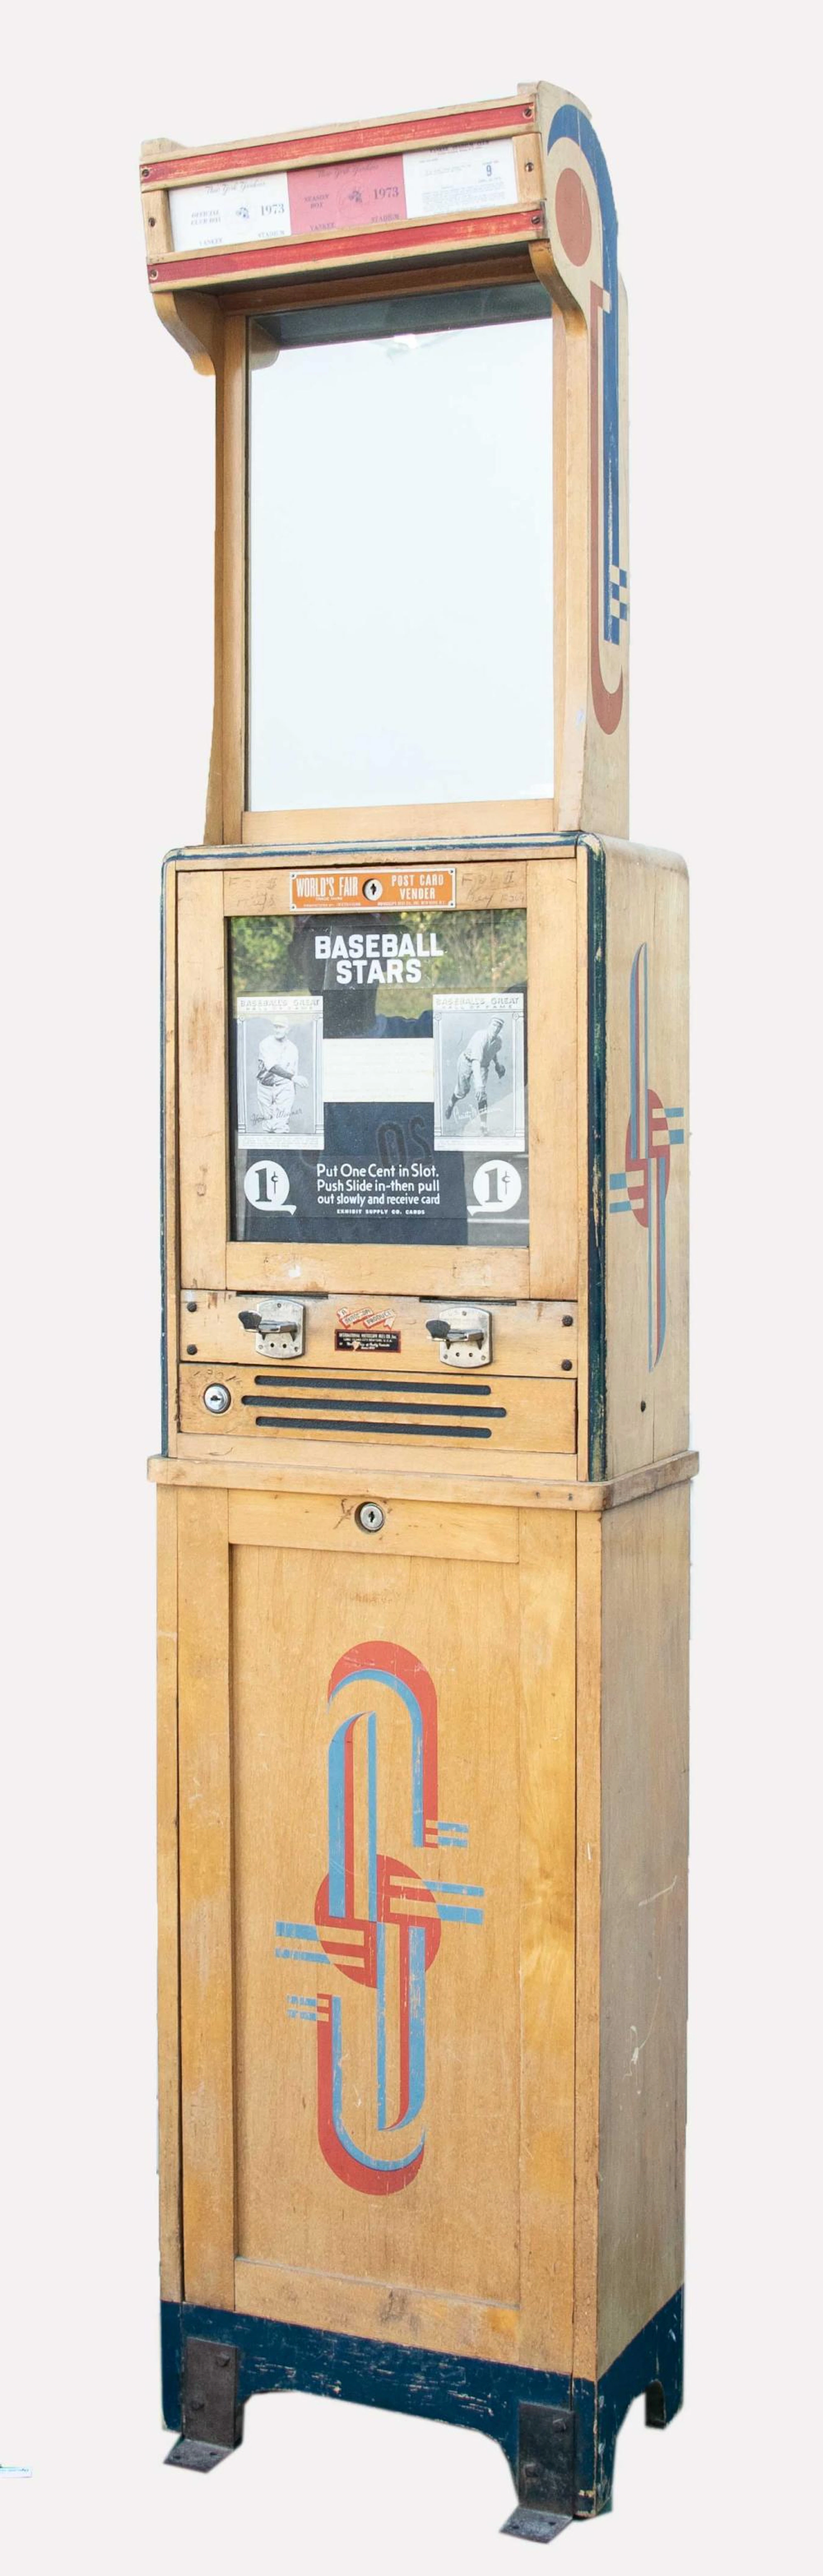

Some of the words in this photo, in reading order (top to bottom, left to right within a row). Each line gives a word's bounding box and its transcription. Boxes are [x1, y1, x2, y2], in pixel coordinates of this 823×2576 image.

[486, 165, 493, 177] 9
[373, 186, 399, 200] 1973
[261, 204, 285, 216] 1973
[296, 877, 334, 897] WORLD'S
[339, 877, 358, 896] FAIR
[391, 875, 414, 886] POST
[420, 874, 444, 886] CARD
[400, 888, 435, 900] VENDER
[315, 933, 444, 959] BASEBALL
[336, 958, 422, 984] STARS
[317, 1163, 338, 1177] Put
[340, 1163, 367, 1177] One
[368, 1163, 396, 1177] Cent
[399, 1164, 408, 1177] in
[411, 1163, 439, 1177] Slot.
[255, 1168, 278, 1202] 1¢
[317, 1179, 344, 1191] Push
[346, 1179, 373, 1191] Slide
[375, 1179, 414, 1191] in-then
[418, 1179, 439, 1194] pull
[485, 1168, 510, 1203] 1¢
[317, 1193, 334, 1204] out
[337, 1193, 366, 1207] slowly
[367, 1193, 384, 1204] and
[387, 1193, 419, 1204] receive
[421, 1193, 440, 1204] card
[366, 1311, 391, 1324] PRODUCT
